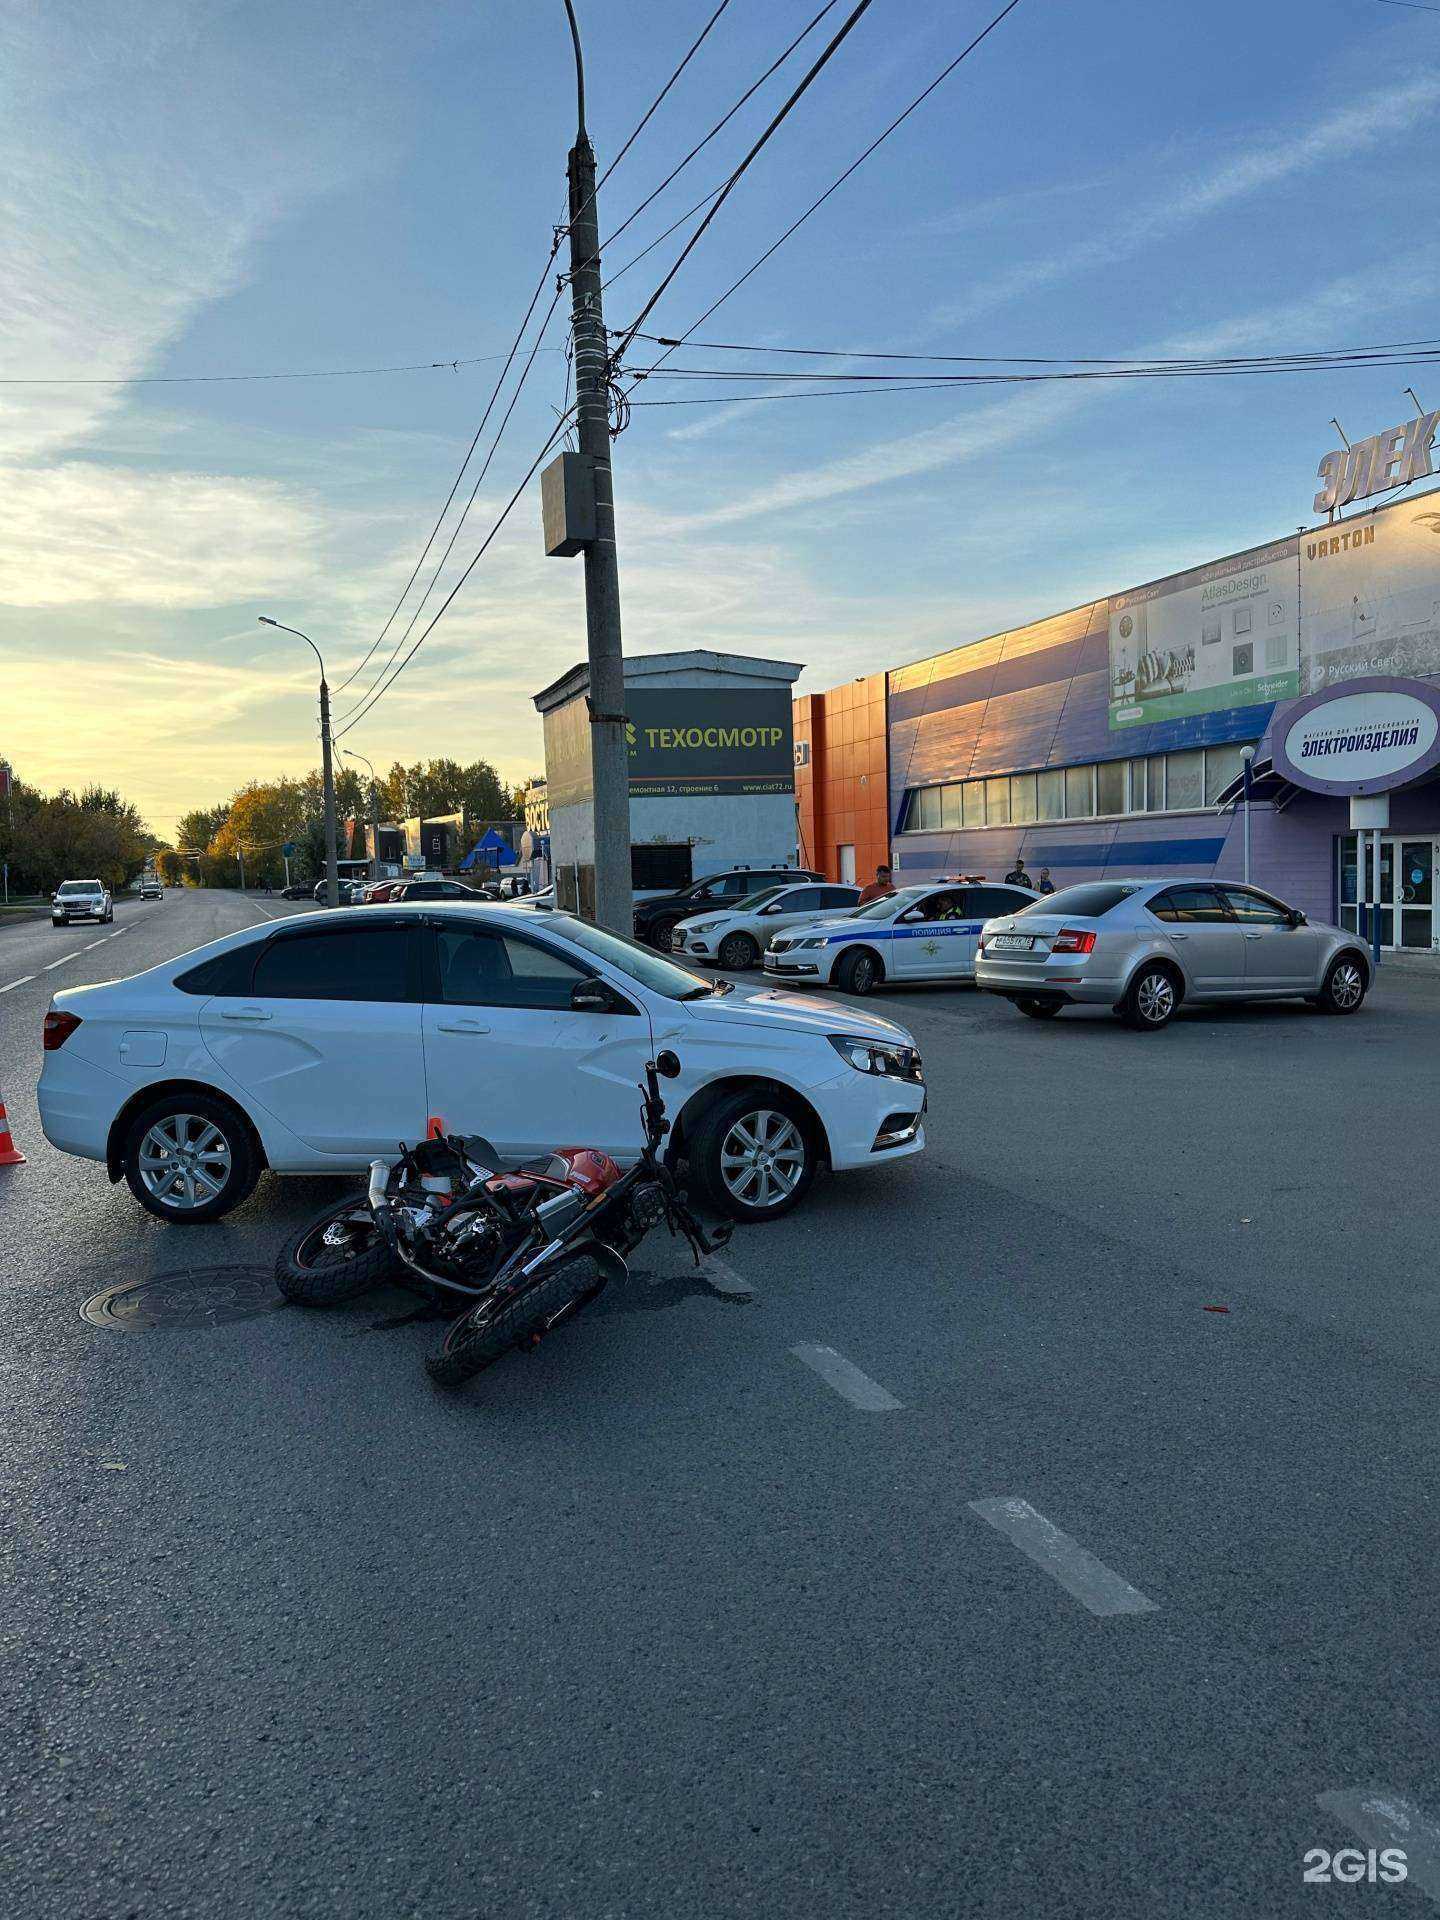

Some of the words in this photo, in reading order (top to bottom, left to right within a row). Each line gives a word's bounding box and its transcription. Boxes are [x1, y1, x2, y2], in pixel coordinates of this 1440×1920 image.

[1307, 525, 1375, 561] VARTON
[1202, 573, 1267, 601] AtlasDesign
[645, 727, 783, 748] ТЕХОСМОТР
[1301, 727, 1419, 758] ЭЛЕКТРОИЗДЕЛИЯ
[679, 786, 713, 795] строение
[713, 784, 719, 792] 6
[912, 927, 952, 937] ПОЛИЦИЯ
